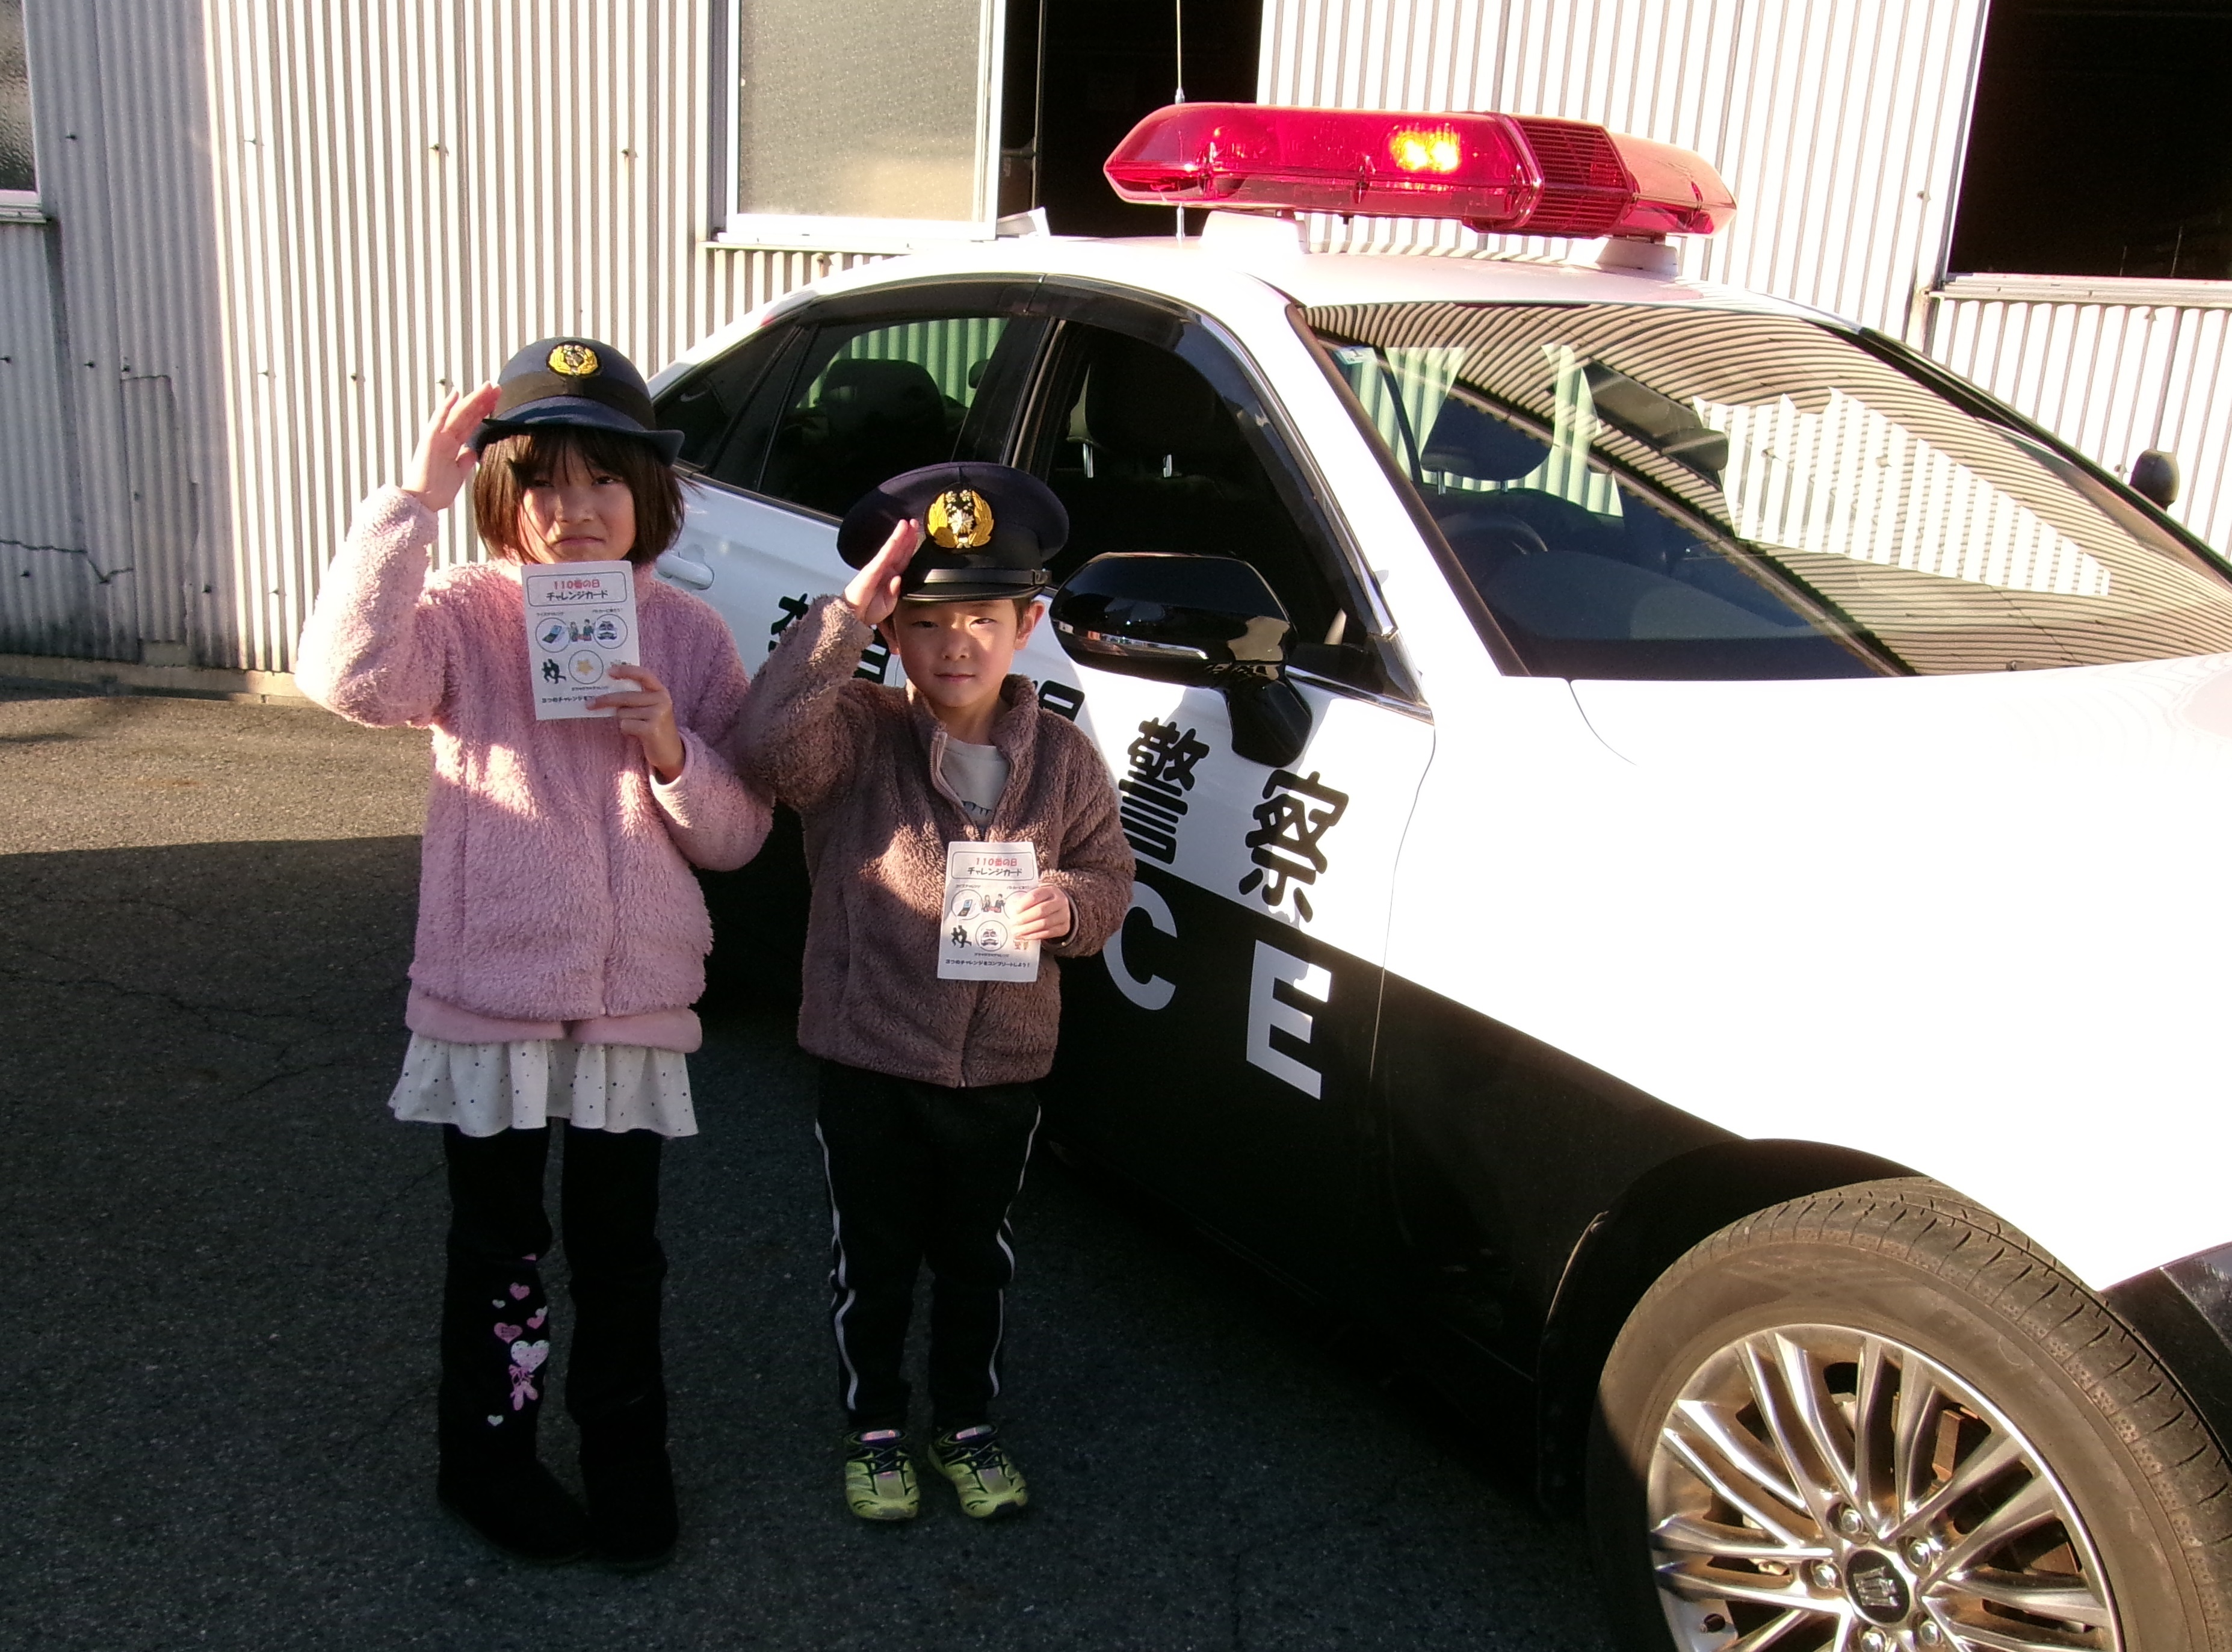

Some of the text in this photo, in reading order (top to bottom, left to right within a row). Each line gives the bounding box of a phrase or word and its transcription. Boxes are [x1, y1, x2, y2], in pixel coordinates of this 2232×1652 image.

[554, 579, 600, 590] 110番の日
[546, 590, 608, 601] チャレンジカード
[1118, 717, 1349, 923] 警察
[975, 857, 1018, 867] 110番の日
[967, 867, 1022, 877] チャレンジカード
